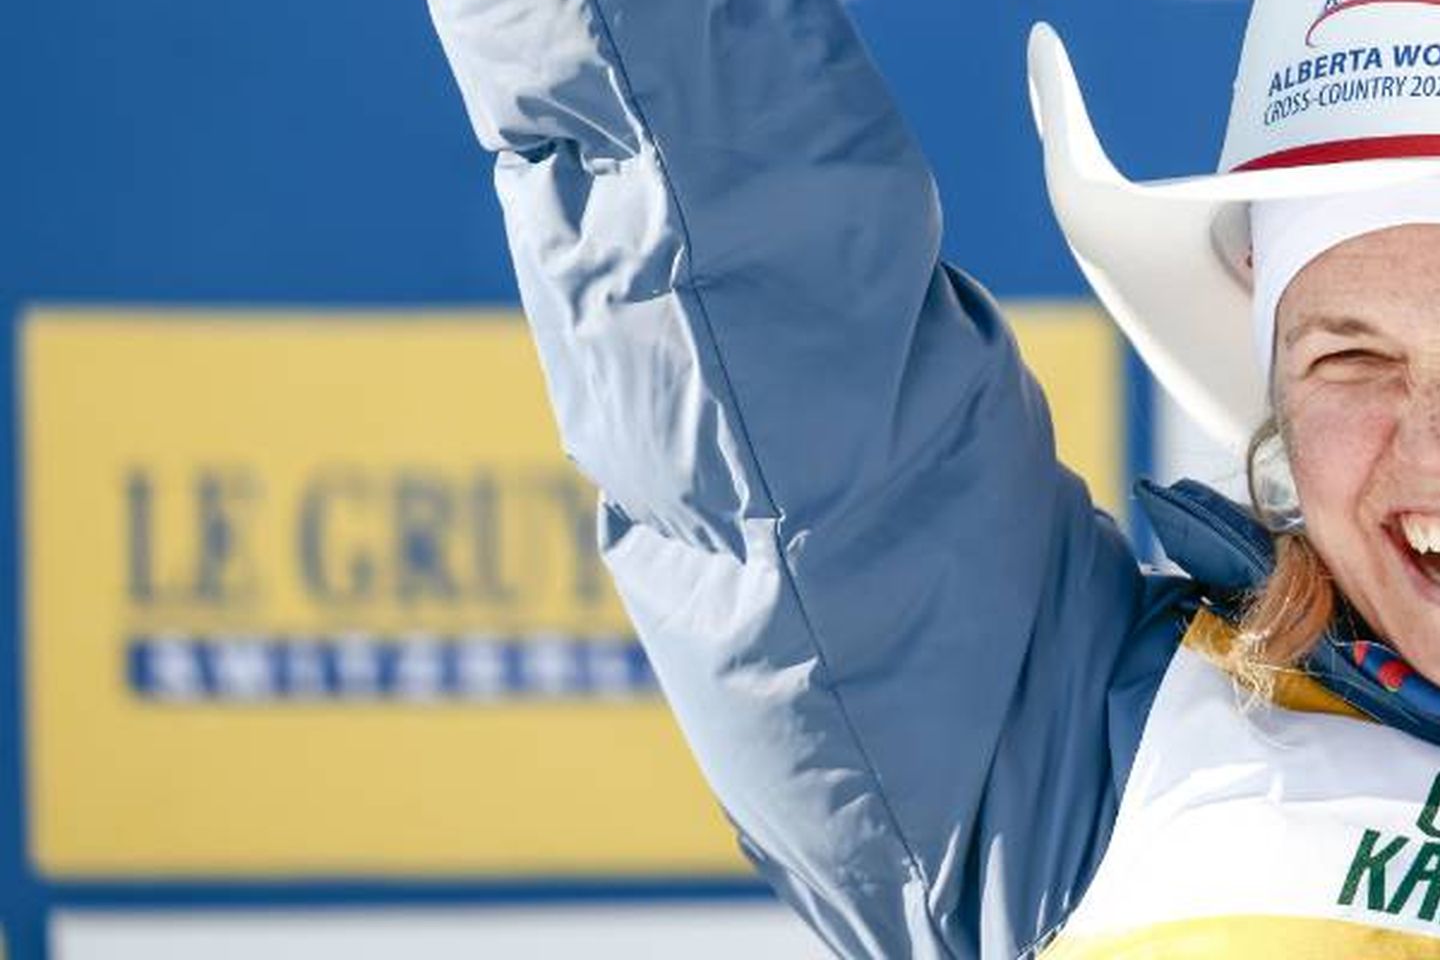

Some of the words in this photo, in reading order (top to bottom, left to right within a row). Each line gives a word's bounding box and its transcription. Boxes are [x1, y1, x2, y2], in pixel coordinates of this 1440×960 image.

[1268, 46, 1383, 97] ALBERTA
[1263, 76, 1406, 127] CROSS-COUNTRY
[126, 464, 258, 610] LE
